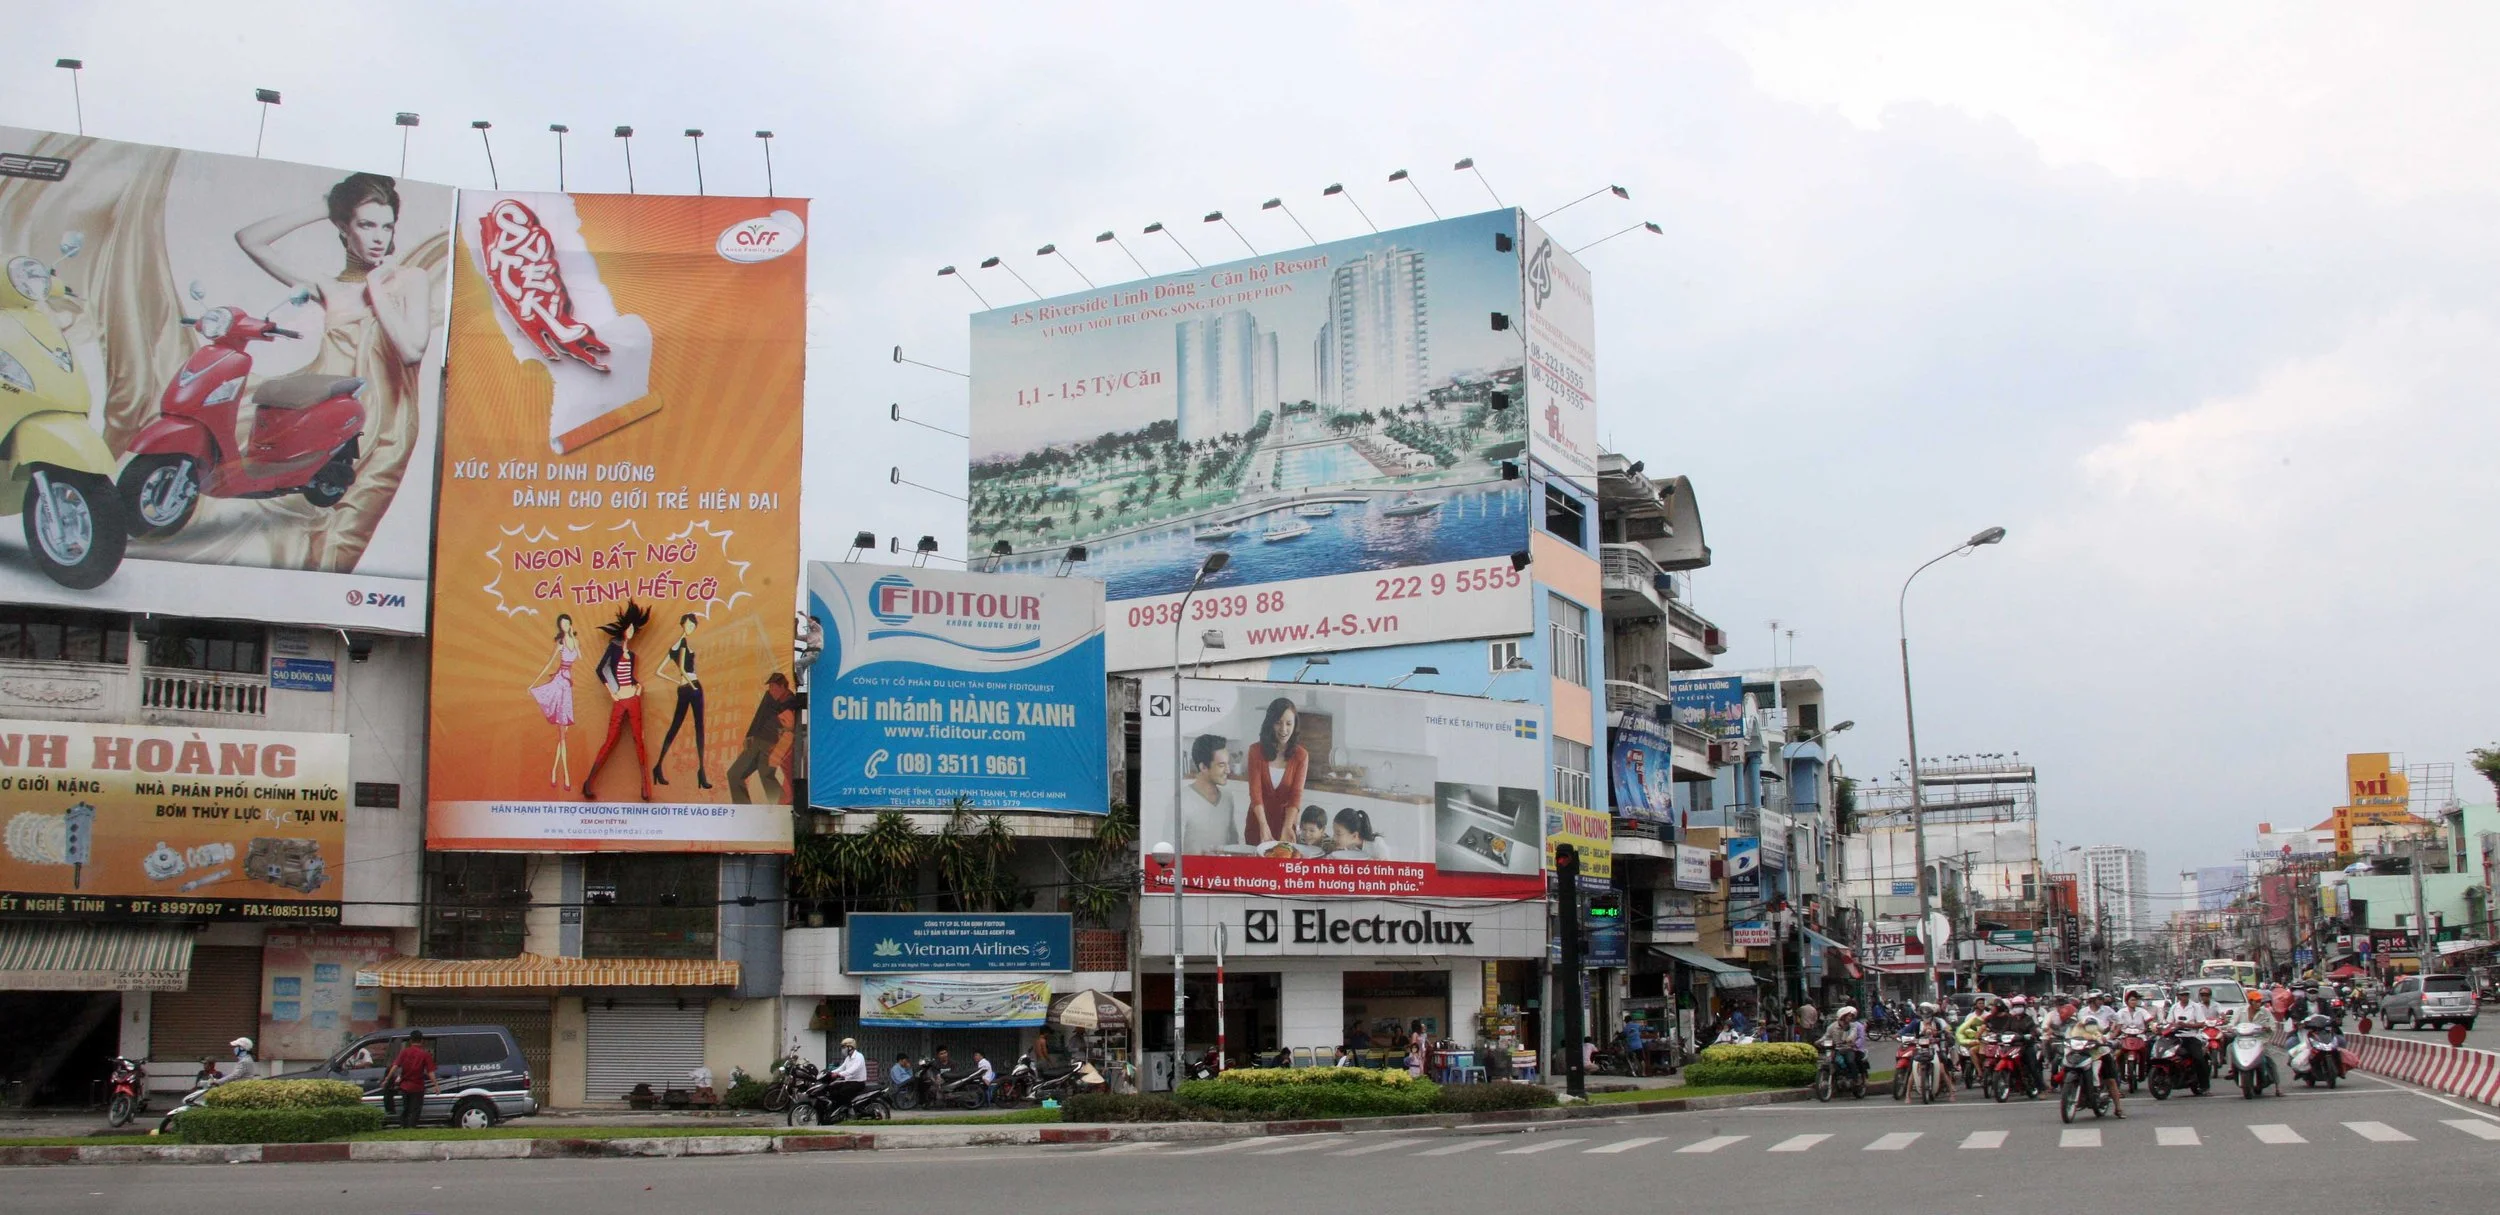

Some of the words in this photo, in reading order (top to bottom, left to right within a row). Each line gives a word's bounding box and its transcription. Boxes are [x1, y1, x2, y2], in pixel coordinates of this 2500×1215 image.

[1011, 310, 1034, 327] 4-S
[1039, 298, 1108, 321] Riverside
[1113, 288, 1148, 307] Linh
[1154, 282, 1195, 300] Đông
[1211, 272, 1243, 289] Căn
[1250, 264, 1269, 283] hộ
[1274, 255, 1328, 276] Resort
[1017, 388, 1041, 408] 1,1
[1061, 379, 1087, 401] 1,5
[1091, 369, 1162, 397] Tỷ/Căn
[454, 457, 489, 480] XÚC
[497, 458, 538, 480] XÍCH
[546, 463, 588, 481] DINH
[596, 461, 655, 482] DƯỠNG
[513, 485, 561, 508] DÀNH
[568, 490, 602, 509] CHO
[610, 487, 648, 509] GIỚI
[656, 485, 690, 510] TRẺ
[699, 487, 740, 513] HIỆN
[749, 491, 779, 514] ĐẠI
[513, 545, 583, 570] NGON
[592, 541, 637, 569] BẤT
[646, 538, 699, 564] NGỜ
[533, 574, 564, 599] CÁ
[571, 579, 631, 604] TÍNH
[637, 569, 684, 598] HẾT
[685, 576, 718, 601] CỠ
[1375, 576, 1422, 600] 222
[1430, 573, 1446, 595] 9
[1456, 566, 1521, 592] 5555
[366, 592, 406, 608] SYM
[882, 587, 1041, 621] FIDITOUR
[1128, 602, 1183, 627] 0938
[1191, 595, 1248, 621] 3939
[1256, 591, 1284, 614] 88
[1247, 614, 1399, 645] www.4-S.vn
[273, 670, 290, 680] SAO
[315, 672, 333, 683] NAM
[881, 678, 890, 686] TY
[1009, 683, 1056, 693] FIDITOURIST
[832, 695, 868, 720] Chi
[875, 696, 943, 722] nhánh
[950, 693, 1010, 725] HÀNG
[1016, 701, 1076, 727] XANH
[1426, 715, 1447, 726] THIẾT
[884, 724, 1026, 741] www.fiditour.com
[91, 732, 297, 778] HOÀNG
[896, 753, 932, 775] (08)
[937, 753, 979, 776] 3511
[986, 755, 1027, 776] 9661
[17, 774, 49, 791] GIỚI
[57, 777, 105, 797] NẶNG.
[136, 780, 165, 796] NHÀ
[172, 782, 211, 798] PHÂN
[214, 780, 248, 799] PHỐI
[254, 783, 296, 800] CHÍNH
[301, 783, 339, 801] THỨC
[842, 787, 856, 795] 271
[1046, 791, 1066, 799] MINH
[156, 805, 187, 818] BƠM
[192, 802, 230, 819] THỦY
[234, 807, 261, 824] LỰC
[295, 809, 316, 825] TẠI
[320, 810, 344, 823] VN.
[1313, 862, 1335, 875] nhà
[1338, 864, 1354, 875] tôi
[1356, 864, 1371, 875] có
[1373, 865, 1395, 876] tính
[1398, 867, 1424, 879] năng
[1193, 875, 1203, 888] vị
[1207, 876, 1230, 888] yêu
[1233, 876, 1281, 890] thương,
[1284, 878, 1315, 889] thêm
[1318, 878, 1355, 892] hương
[1358, 880, 1387, 892] hạnh
[26, 896, 65, 914] NGHỆ
[132, 901, 157, 913] ĐT:
[161, 902, 223, 916] 8997097
[243, 903, 339, 918] FAX:(08)5115190
[1293, 909, 1474, 945] Electrolux
[904, 942, 970, 956] Vietnam
[971, 941, 1030, 956] Airlines
